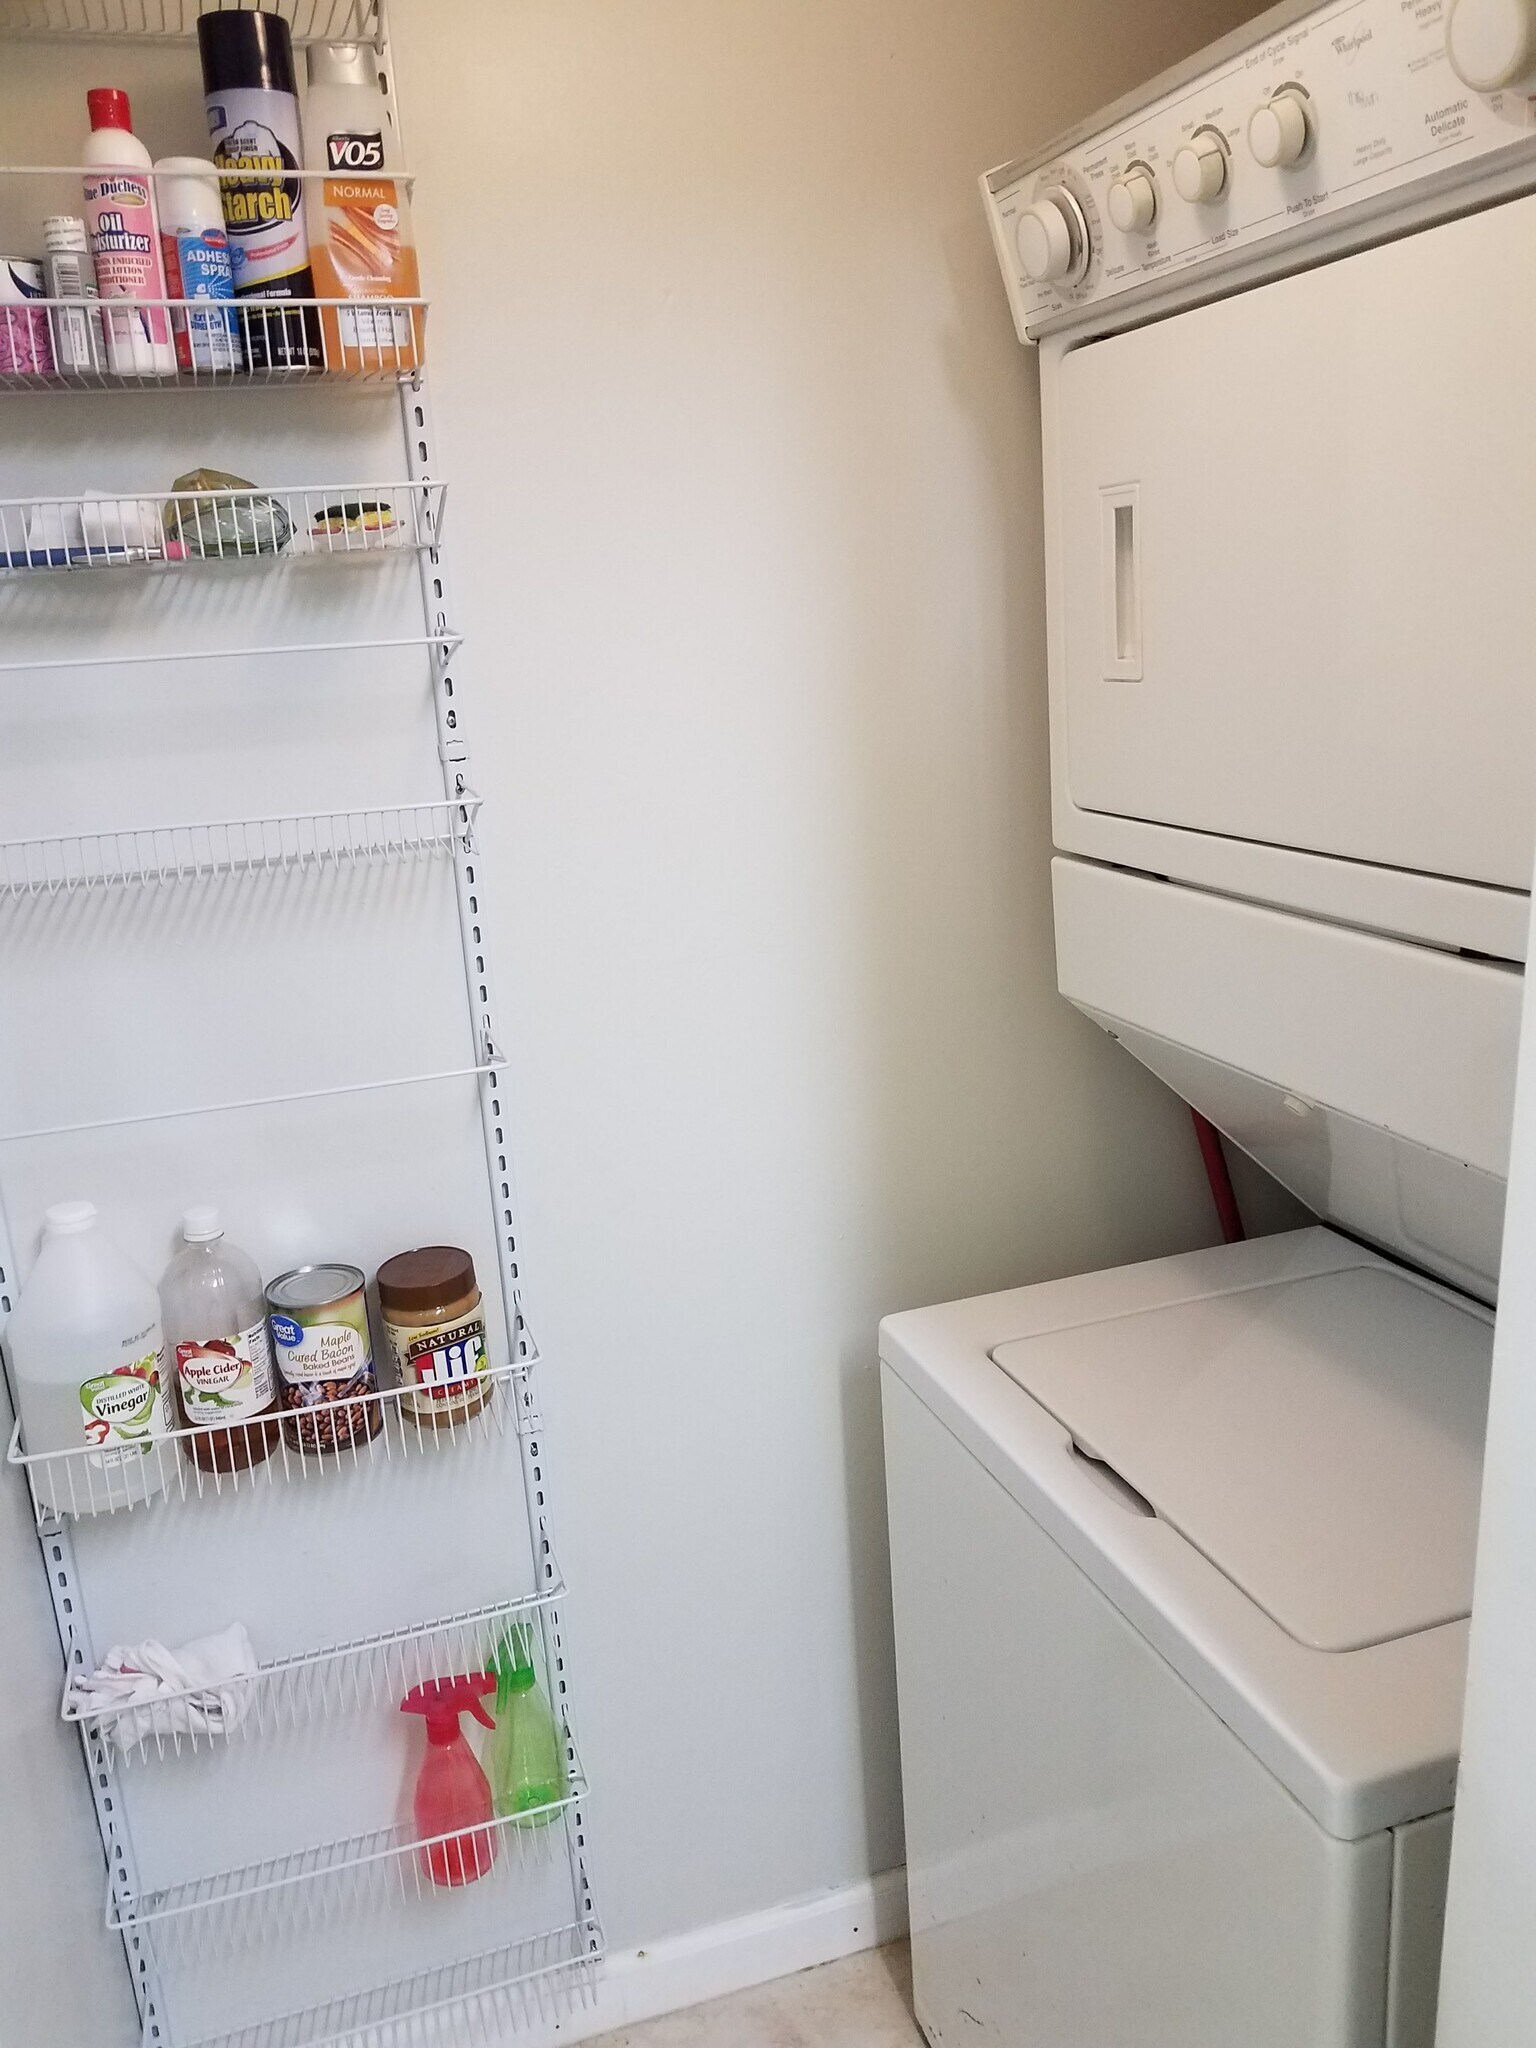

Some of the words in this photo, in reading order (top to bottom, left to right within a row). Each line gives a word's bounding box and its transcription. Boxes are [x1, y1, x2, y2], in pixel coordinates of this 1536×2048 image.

[1245, 56, 1258, 69] End
[1267, 41, 1286, 58] Cycle
[1286, 28, 1309, 46] Signal
[1332, 28, 1373, 55] Whirlpool
[1424, 99, 1468, 124] Automatic
[1430, 115, 1466, 137] Delicate
[329, 141, 381, 166] VO5
[100, 179, 147, 199] Duchess
[1286, 202, 1303, 214] Push
[1303, 198, 1312, 208] To
[1312, 192, 1329, 206] Start
[100, 213, 123, 232] Oil
[93, 232, 150, 252] isturizer
[1211, 231, 1225, 244] Load
[1226, 227, 1239, 239] Size
[112, 257, 151, 266] ENRICHED
[112, 266, 143, 275] LOTION
[201, 264, 232, 277] SPRA
[1141, 255, 1172, 271] Temperature
[271, 1319, 295, 1335] Great
[277, 1332, 296, 1342] Value
[416, 1322, 480, 1351] NATURAL
[321, 1329, 352, 1349] Maple
[288, 1349, 318, 1363] Cured
[321, 1344, 354, 1361] Bacon
[303, 1360, 330, 1371] Baked
[332, 1353, 355, 1367] Beans
[421, 1335, 482, 1384] Jif
[185, 1365, 211, 1378] Apple
[213, 1362, 240, 1375] Cider
[196, 1375, 230, 1385] VINEGAR
[96, 1389, 127, 1405] DISTILLED
[127, 1383, 145, 1395] WHITE
[96, 1391, 148, 1417] Vinegar
